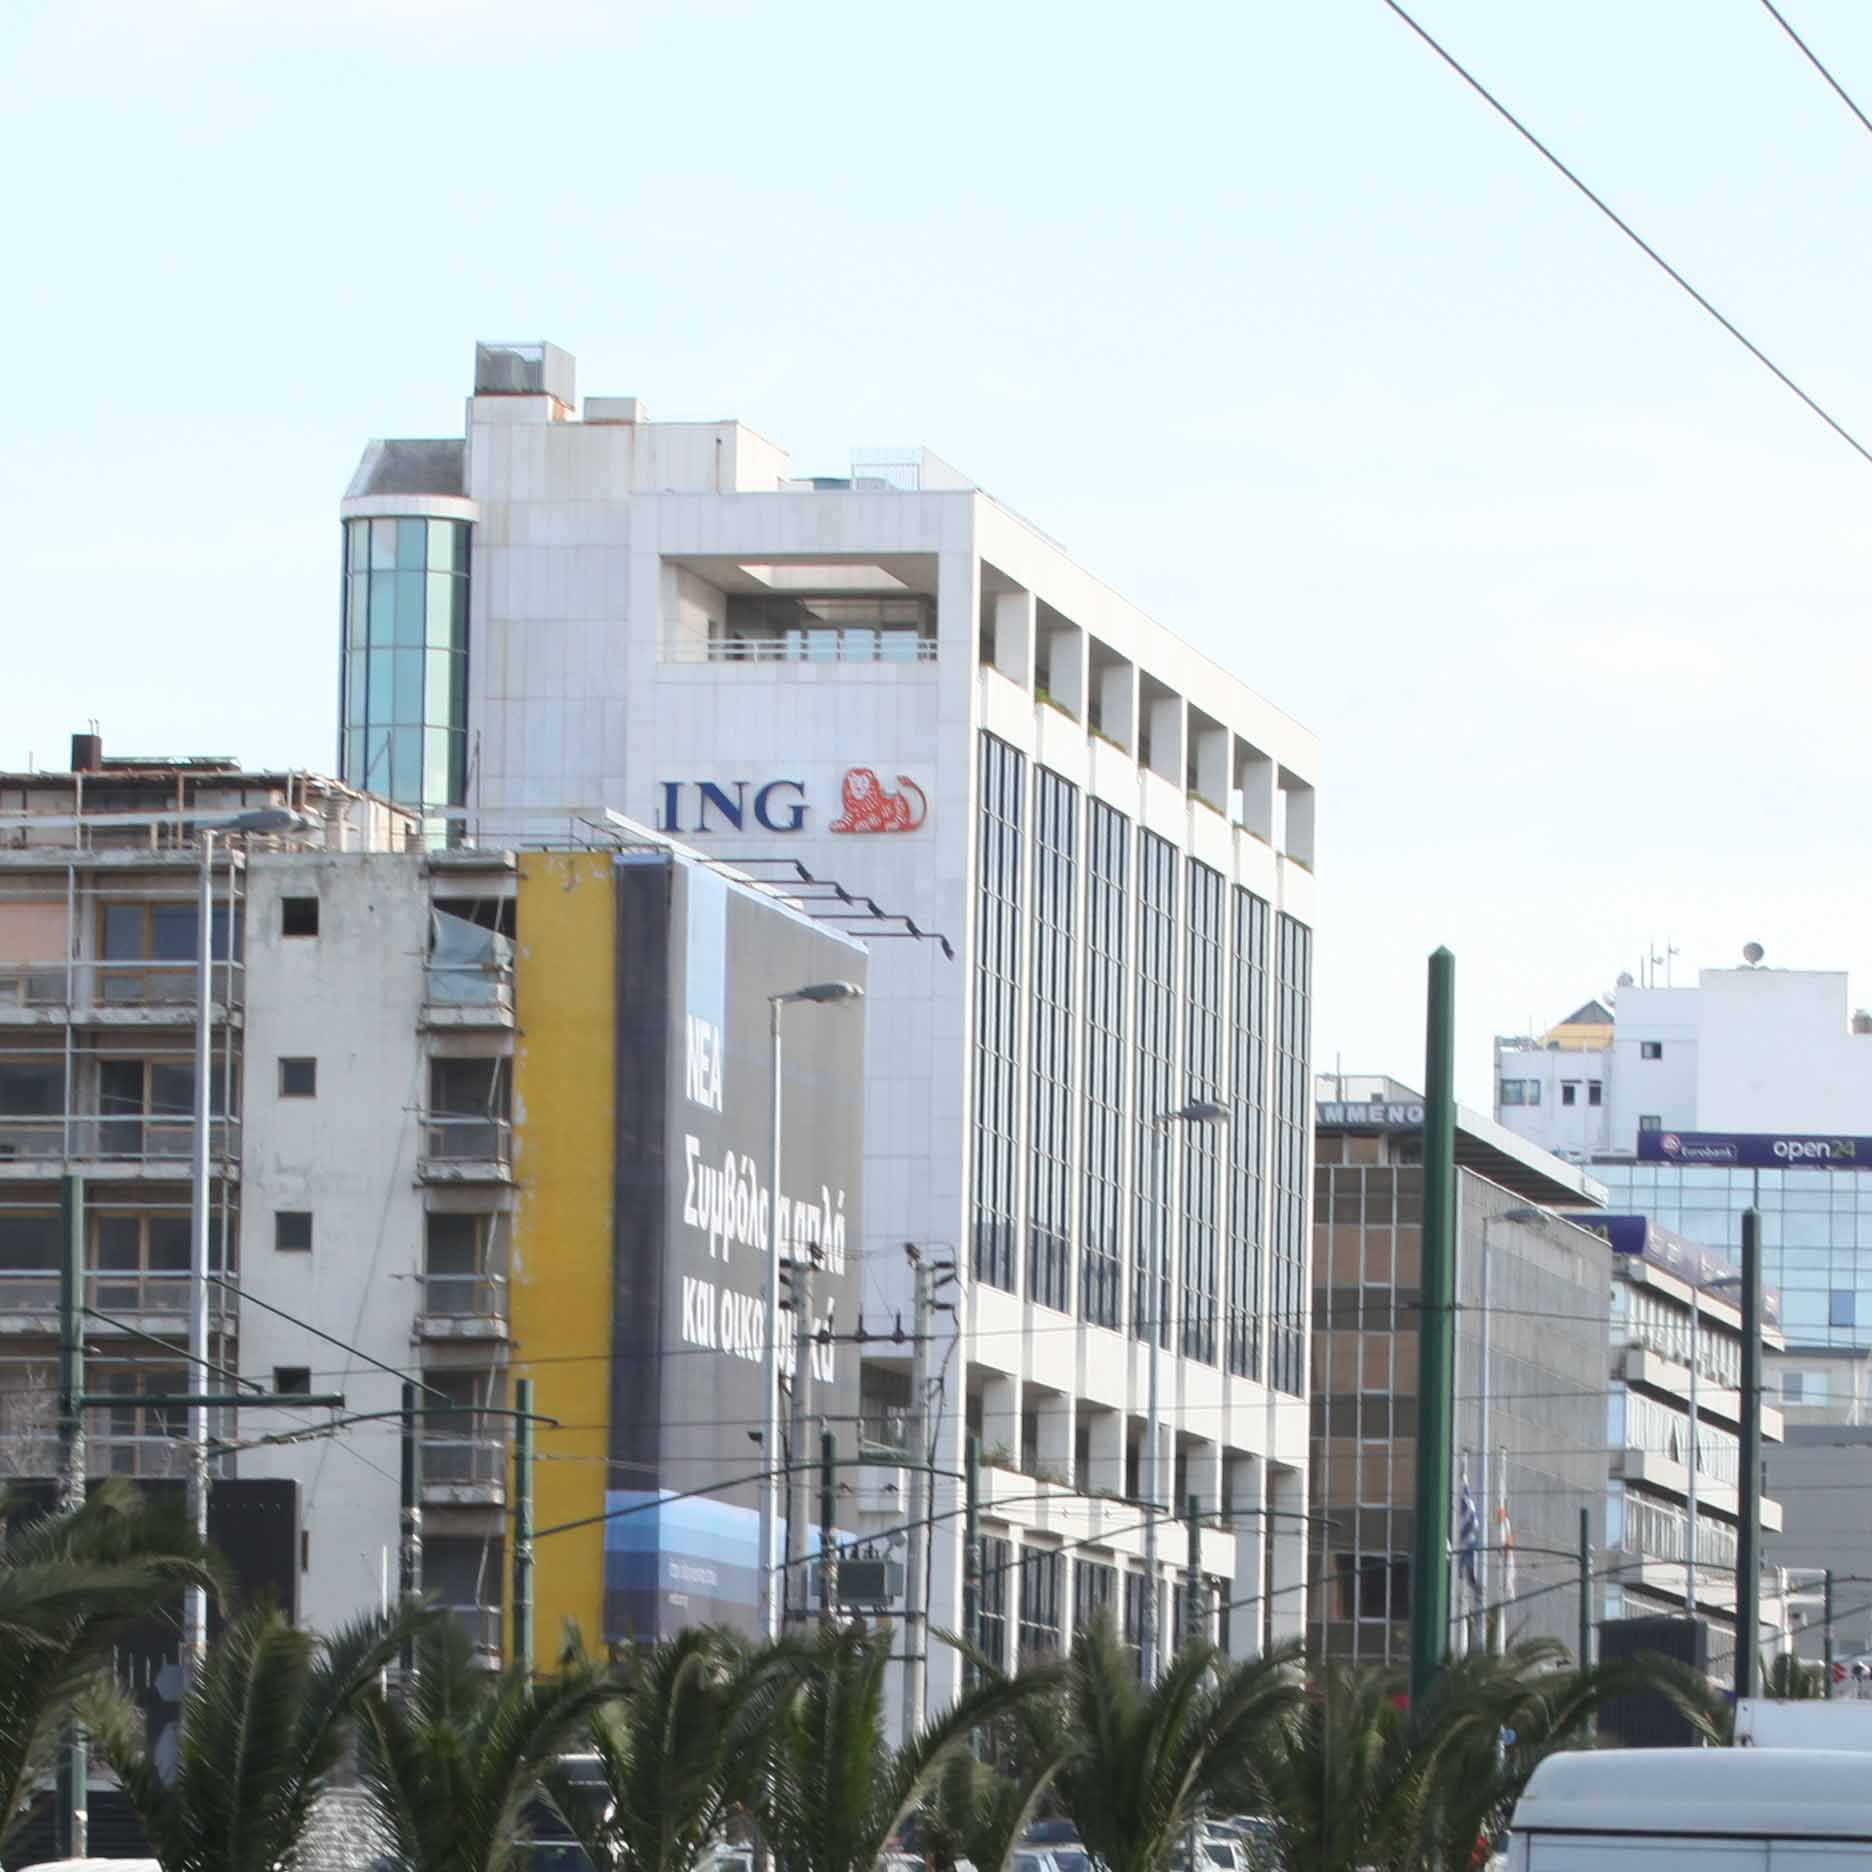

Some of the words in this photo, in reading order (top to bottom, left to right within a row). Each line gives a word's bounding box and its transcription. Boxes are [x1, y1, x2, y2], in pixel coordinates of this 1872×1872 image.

[660, 779, 807, 833] ING
[686, 1014, 722, 1113] ΝΕΑ
[682, 1275, 716, 1350] και
